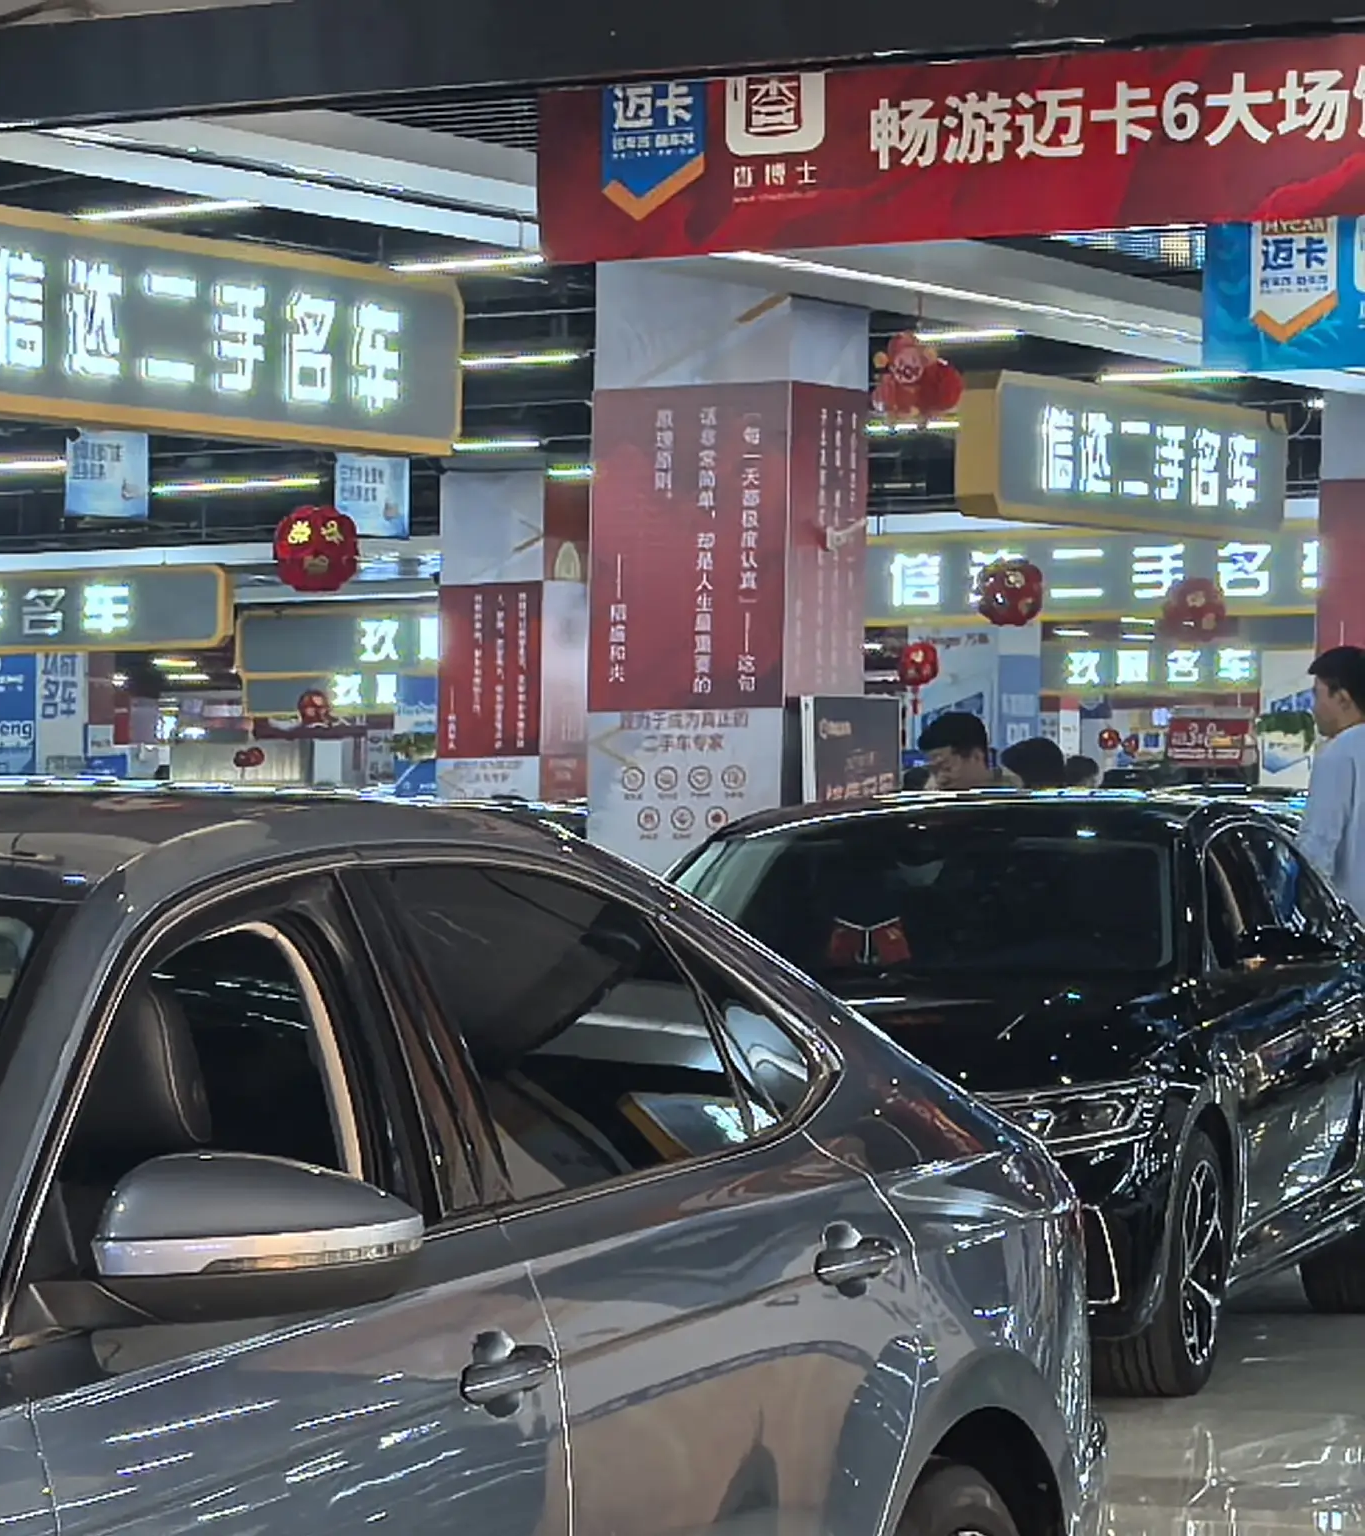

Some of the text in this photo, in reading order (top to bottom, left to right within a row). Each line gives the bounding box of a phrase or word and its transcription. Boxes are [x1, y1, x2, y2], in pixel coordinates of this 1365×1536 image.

[614, 85, 693, 129] 迈卡
[1262, 237, 1328, 271] 迈卡
[1043, 405, 1258, 510] 信达二手名车
[891, 541, 1323, 607] 信二手名
